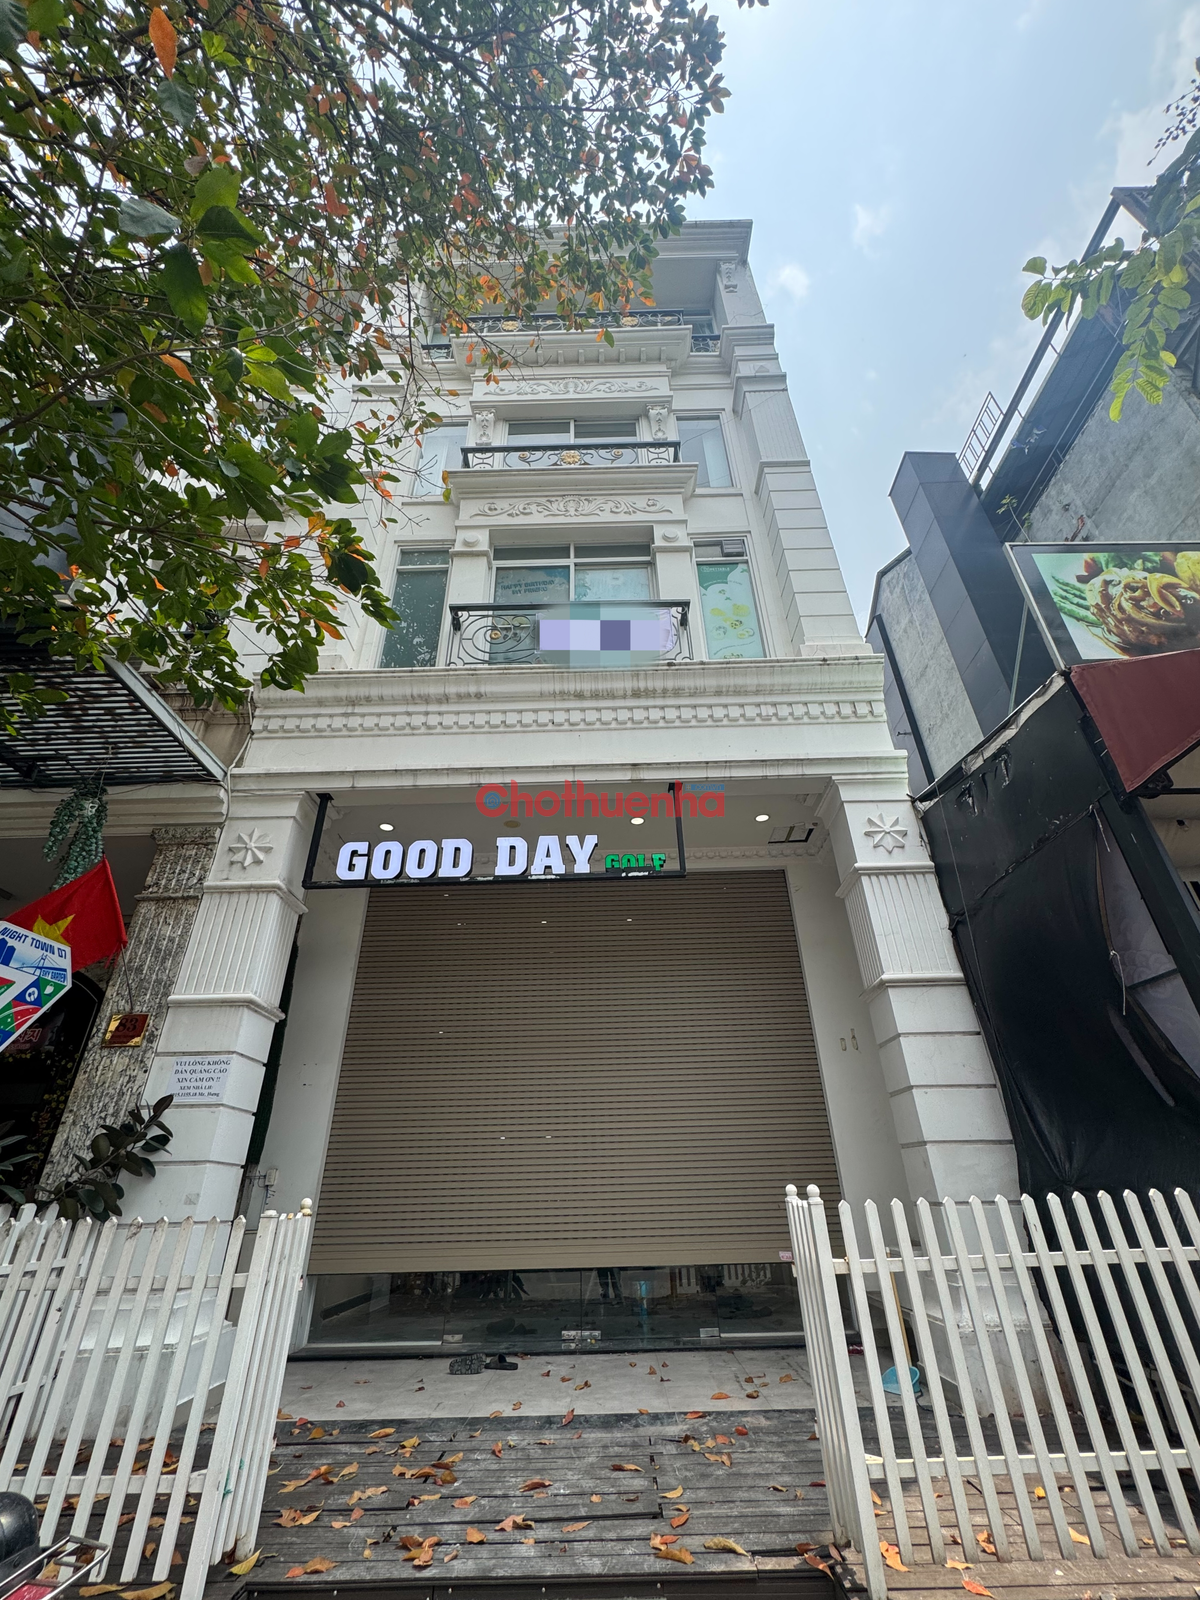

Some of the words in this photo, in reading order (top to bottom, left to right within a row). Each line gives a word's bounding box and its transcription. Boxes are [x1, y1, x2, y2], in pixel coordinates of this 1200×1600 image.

[501, 583, 523, 591] HAPPY
[524, 580, 555, 588] BIRTHDAY
[335, 838, 474, 881] GOOD
[494, 834, 600, 877] DAY
[605, 853, 667, 872] GOLF
[0, 926, 29, 943] NIGHT
[30, 937, 55, 955] TOWN
[117, 1017, 139, 1033] 83
